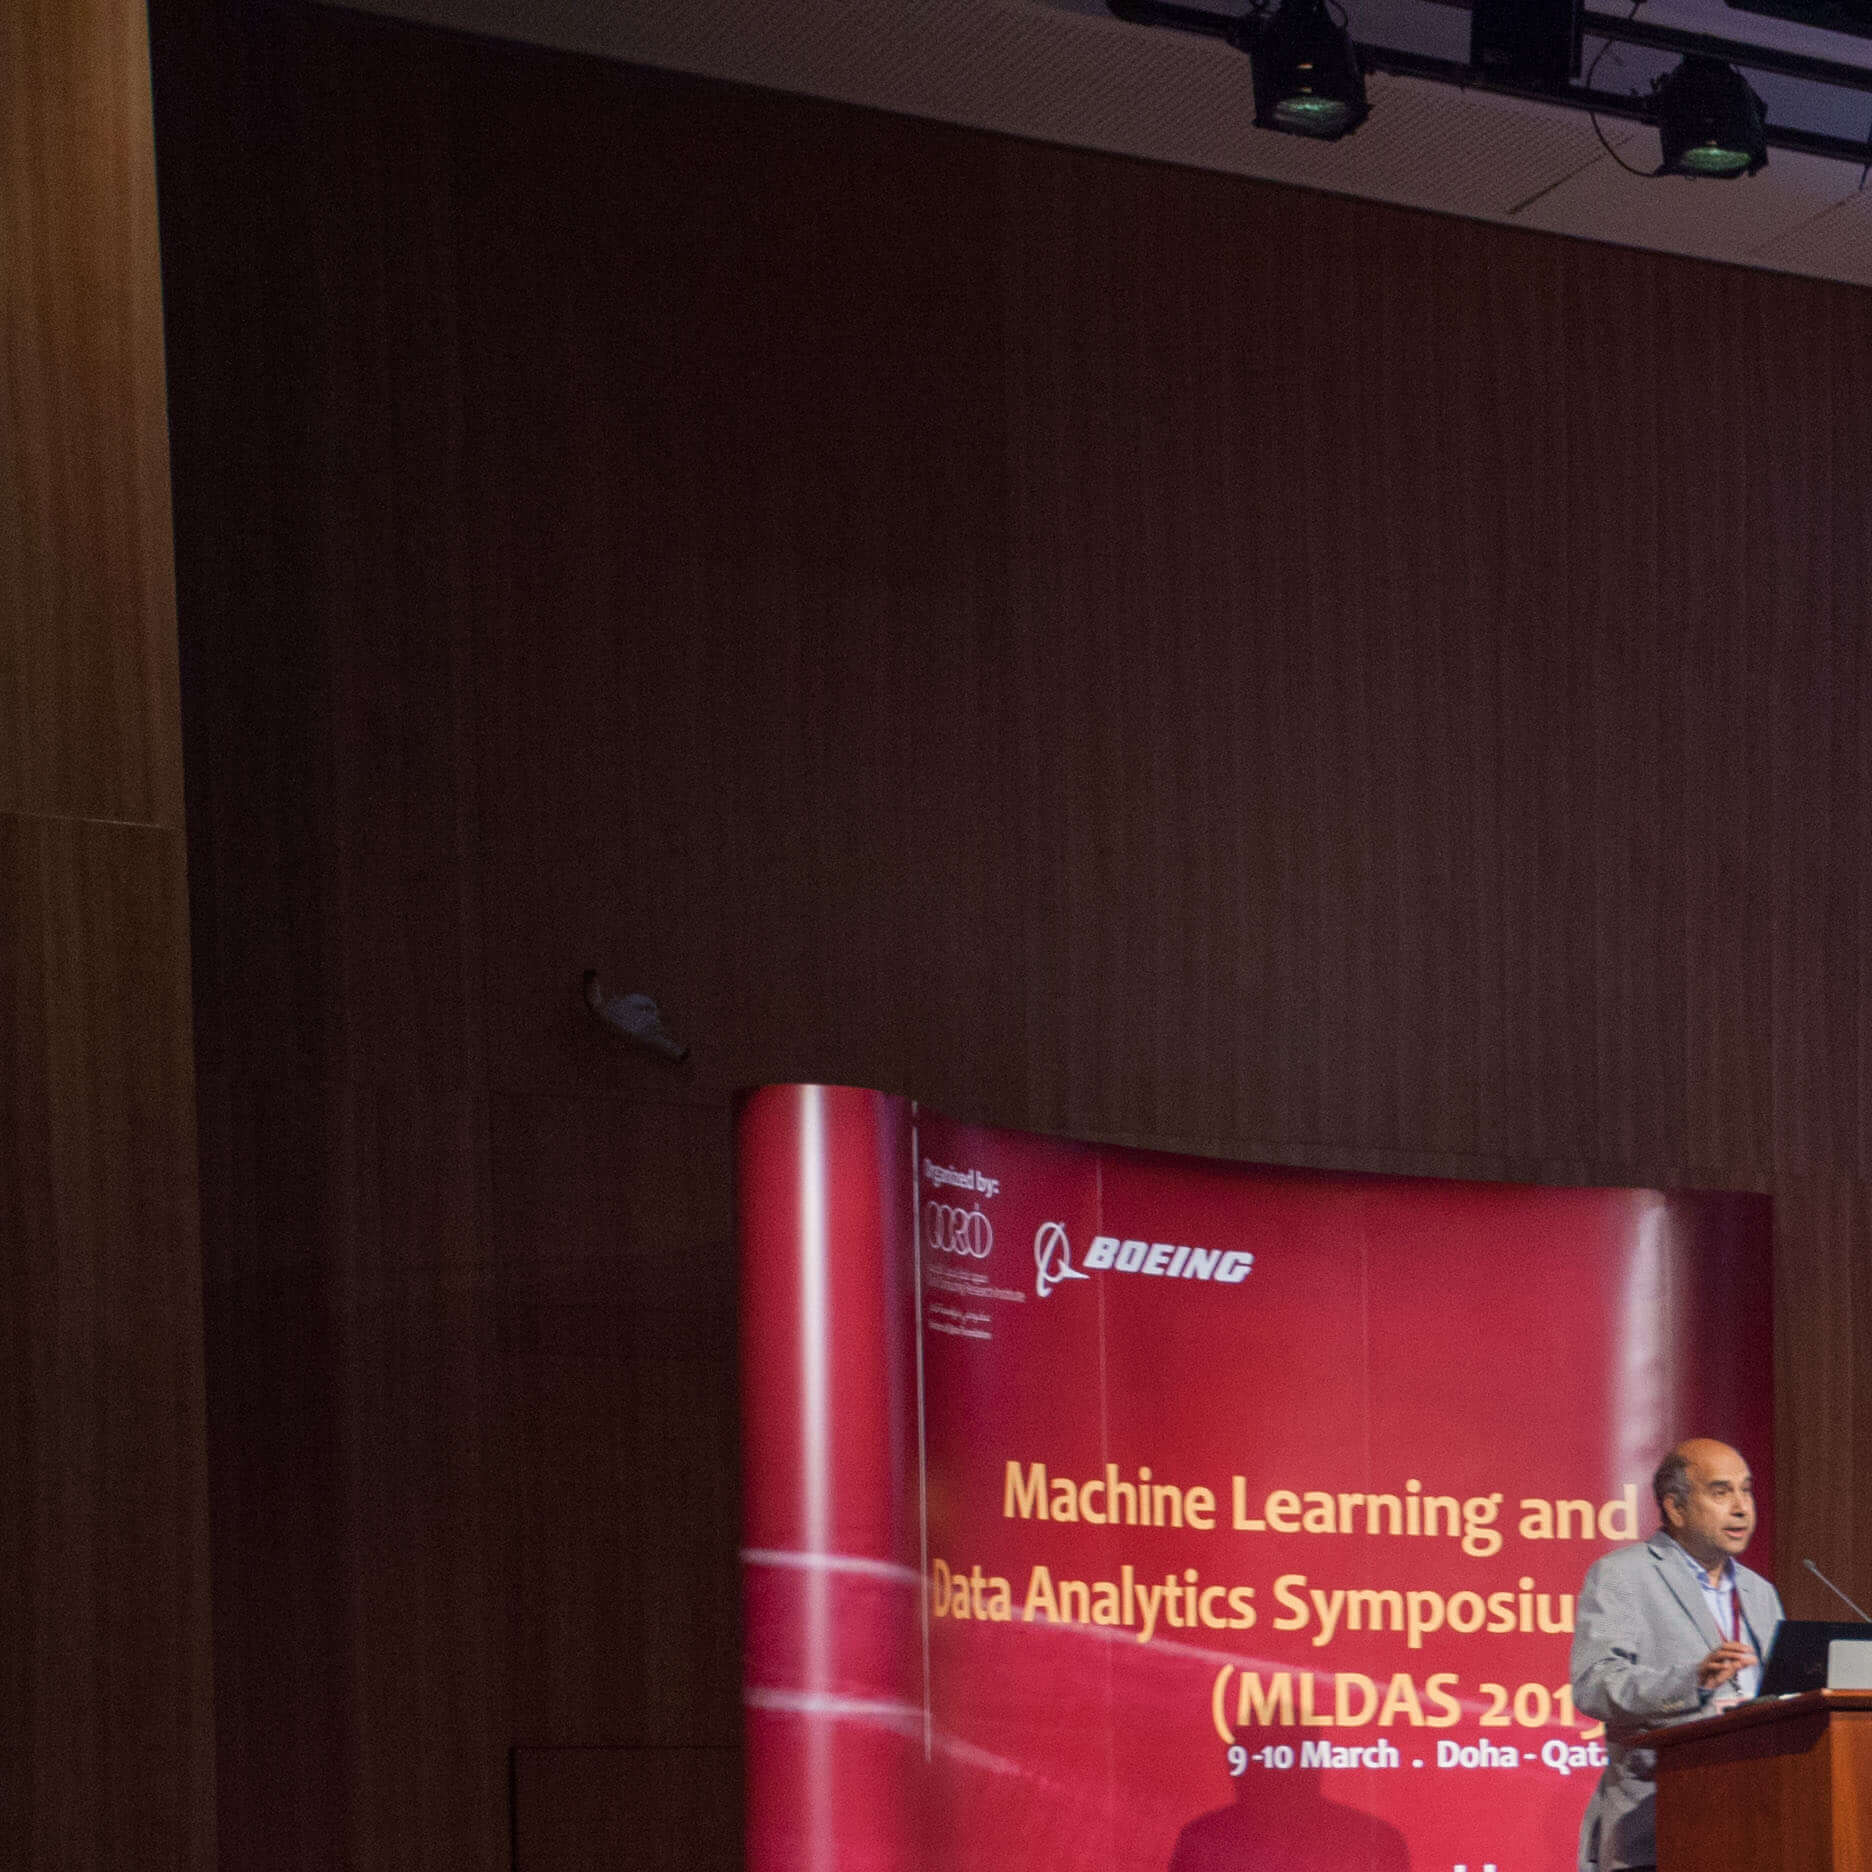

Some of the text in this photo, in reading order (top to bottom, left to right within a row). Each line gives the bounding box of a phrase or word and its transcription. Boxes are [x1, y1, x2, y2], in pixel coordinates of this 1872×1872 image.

[1083, 1236, 1255, 1284] BOEING
[1003, 1460, 1640, 1558] Machine Learning and
[931, 1558, 1575, 1649] Data Analytics Symposiu
[1212, 1664, 1606, 1745] (MLDAS 201
[1301, 1739, 1399, 1769] March
[1437, 1739, 1519, 1769] Doha
[1541, 1739, 1609, 1776] Qat
